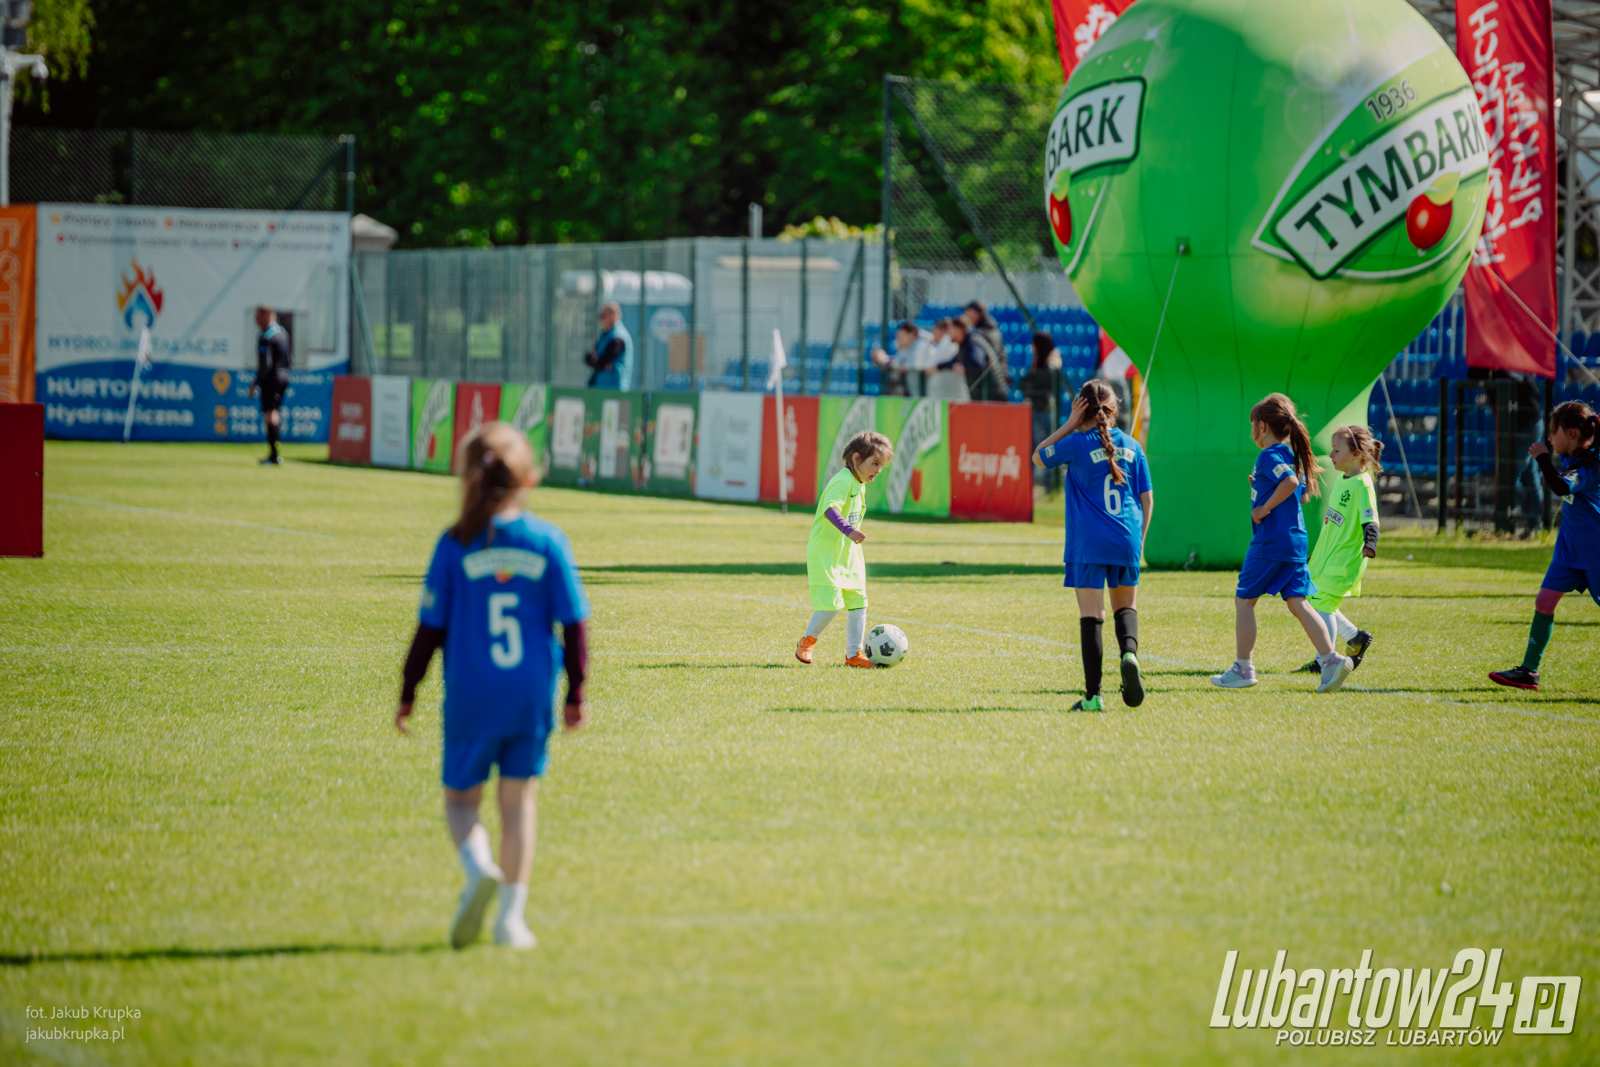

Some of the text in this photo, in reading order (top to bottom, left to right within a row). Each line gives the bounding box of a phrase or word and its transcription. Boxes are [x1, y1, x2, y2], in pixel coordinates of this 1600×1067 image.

[1367, 80, 1416, 122] 1936
[1294, 102, 1486, 250] TYMBARK
[1104, 474, 1121, 516] 6
[488, 592, 523, 669] 5
